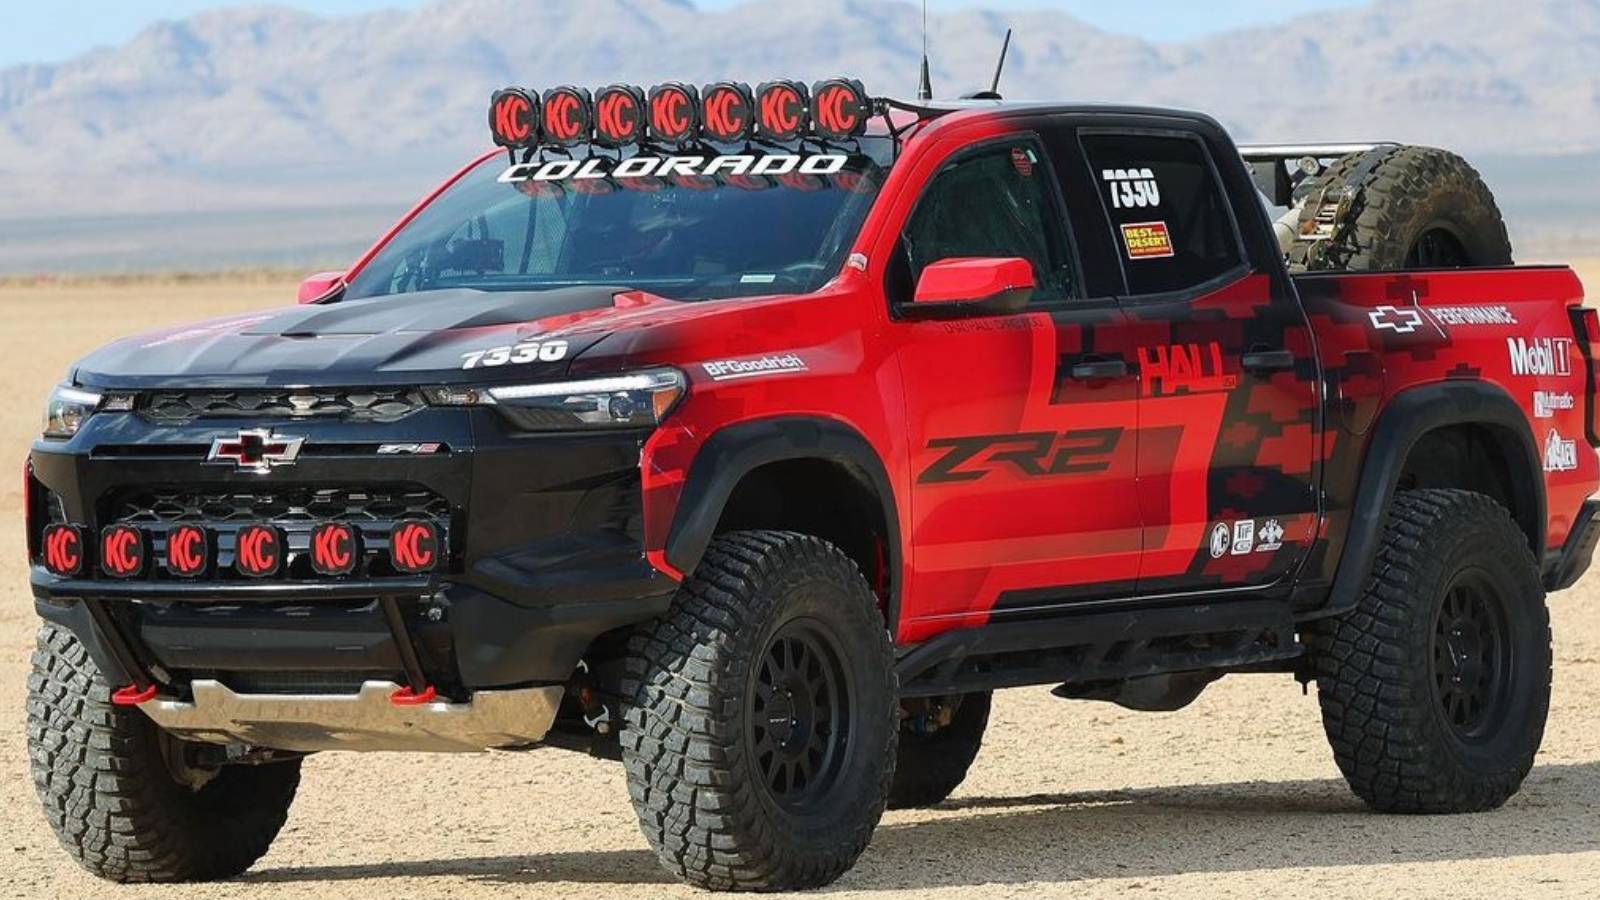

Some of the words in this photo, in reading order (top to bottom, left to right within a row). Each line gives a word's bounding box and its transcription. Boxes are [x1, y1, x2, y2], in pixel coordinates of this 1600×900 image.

[496, 95, 529, 141] KC
[547, 94, 580, 139] KC
[599, 93, 633, 139] KC
[653, 90, 688, 136] KC
[706, 90, 741, 136] KC
[762, 87, 798, 134] KC
[819, 86, 855, 132] KC
[498, 154, 848, 183] COLORADO
[1103, 168, 1160, 208] 7330
[1128, 236, 1167, 247] DESERT
[461, 340, 569, 370] 7330
[702, 353, 805, 376] BFGoodrich
[1137, 341, 1225, 394] HALL
[1506, 337, 1554, 375] Mobil
[917, 427, 1125, 484] ZR2
[48, 527, 77, 571] KC
[106, 529, 137, 573] KC
[171, 528, 201, 572] KC
[241, 528, 273, 572] KC
[316, 525, 350, 569] KC
[395, 524, 431, 568] KC
